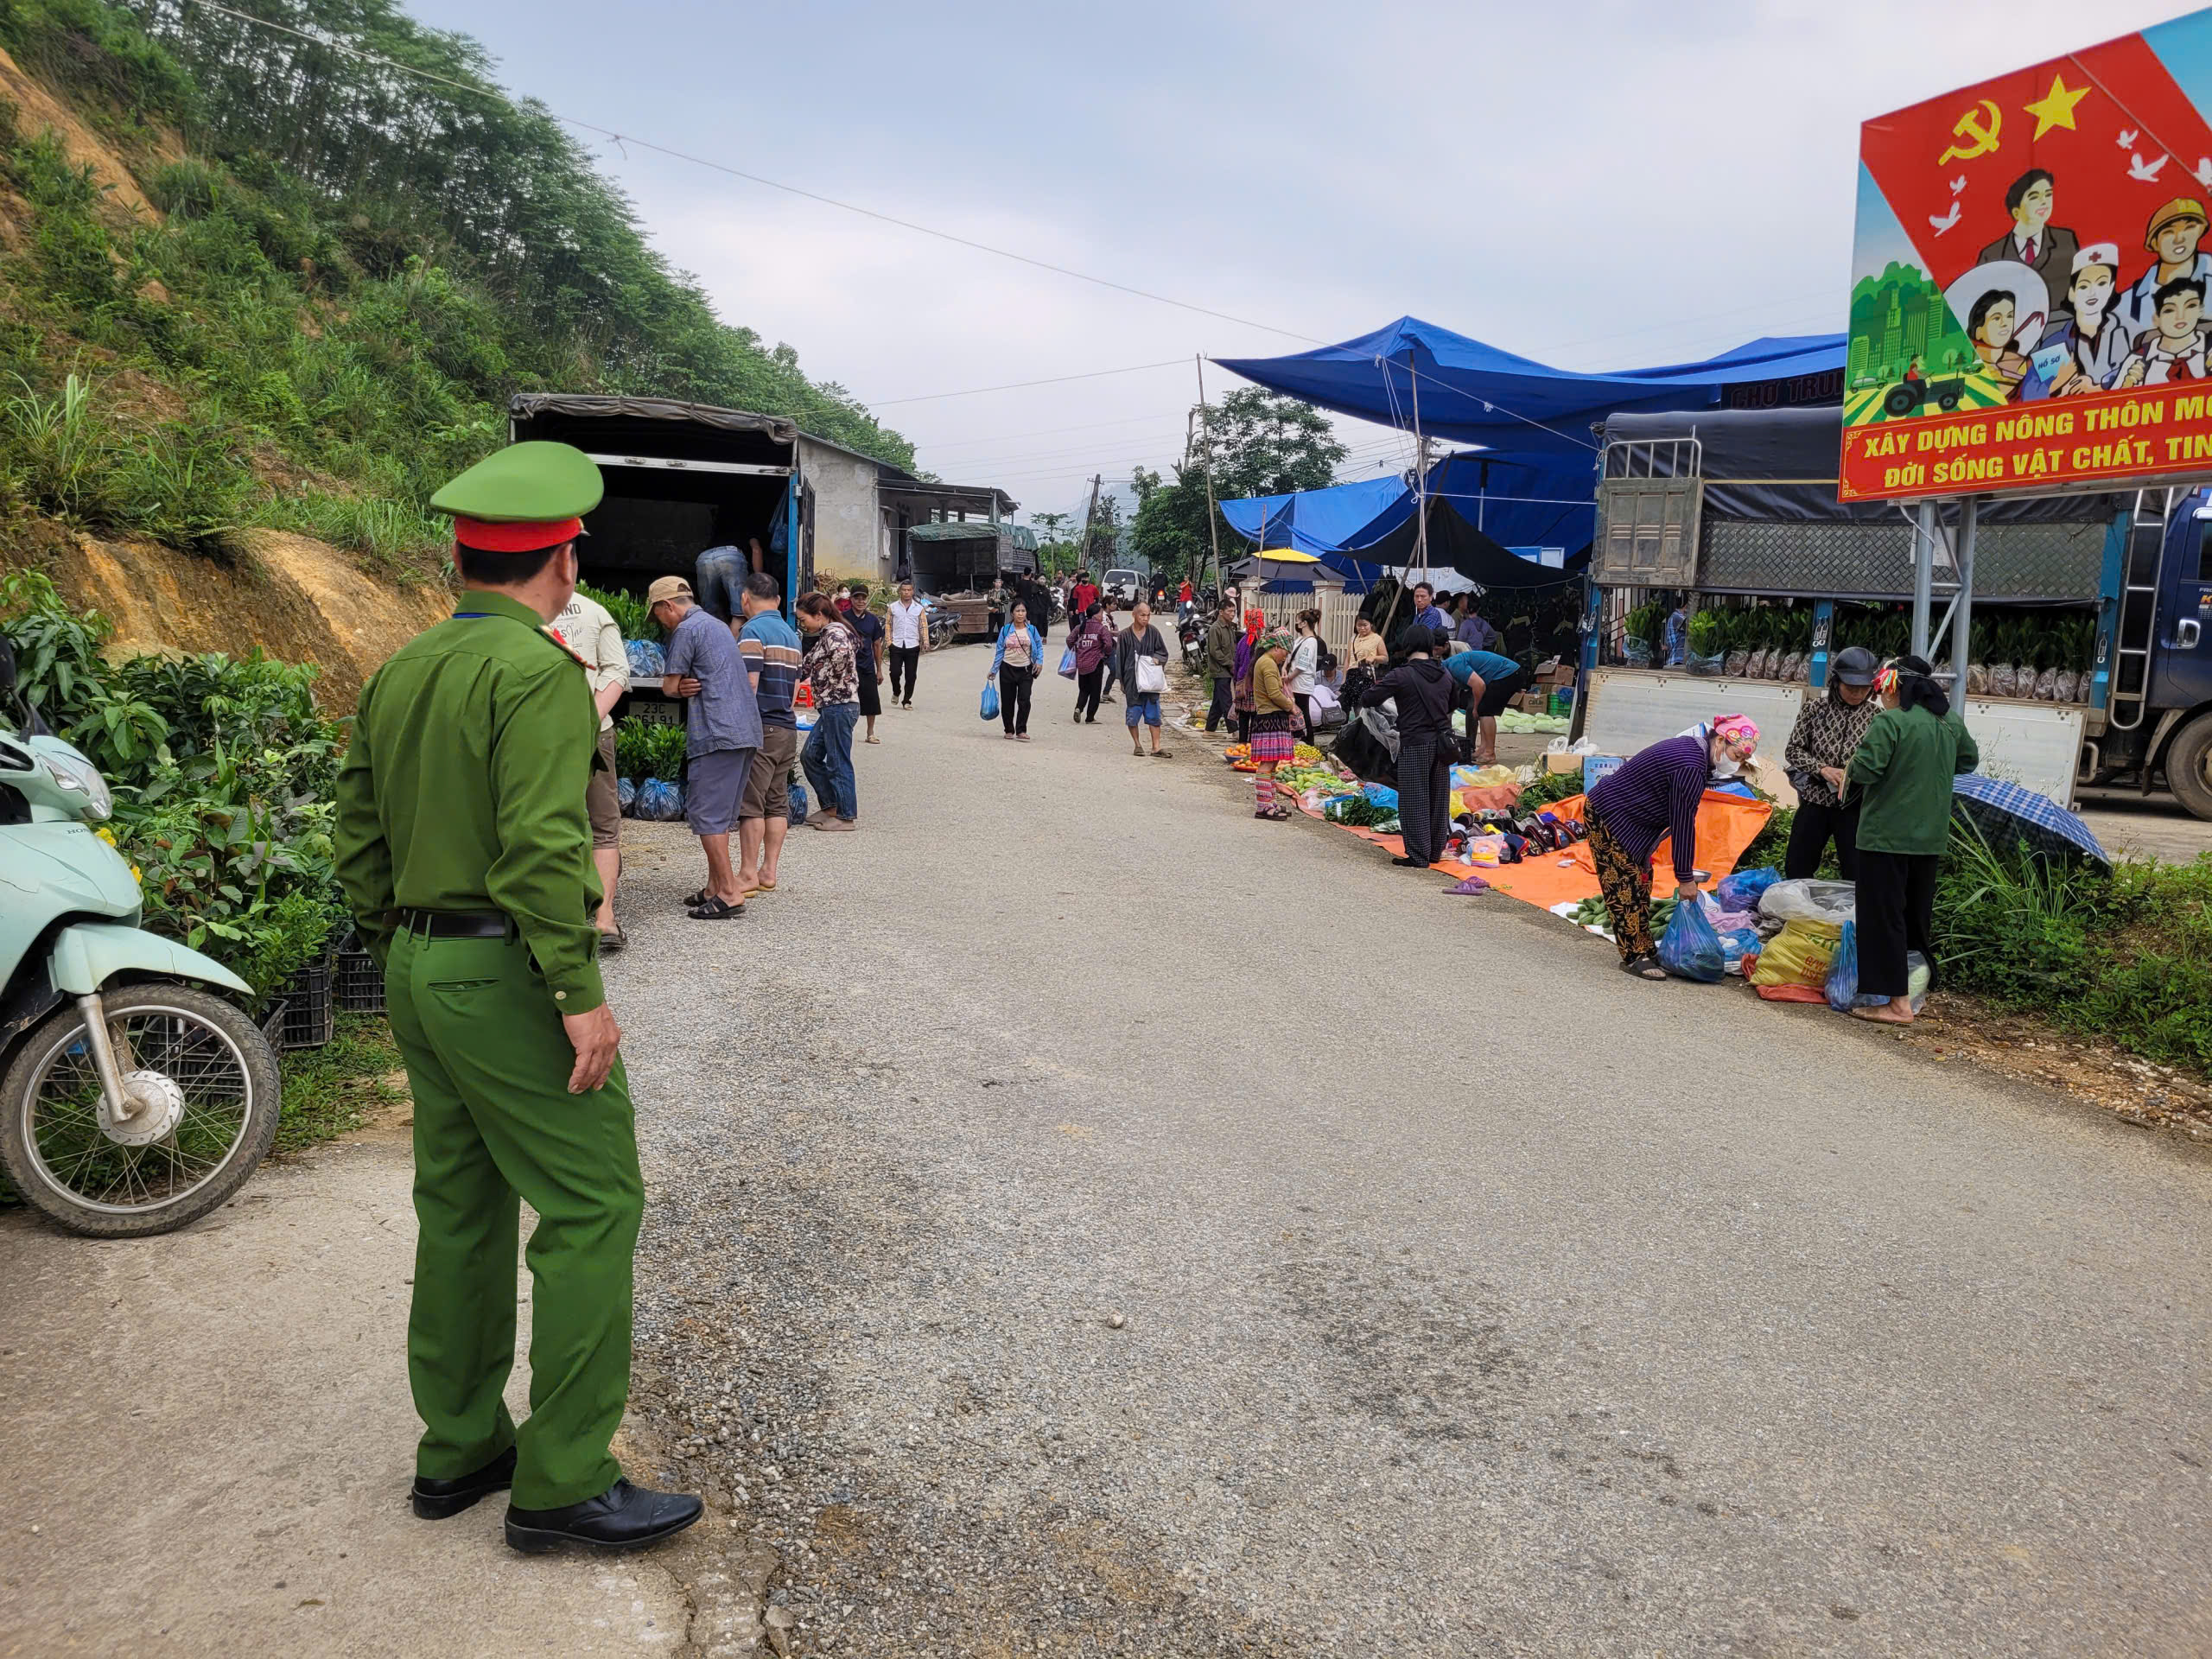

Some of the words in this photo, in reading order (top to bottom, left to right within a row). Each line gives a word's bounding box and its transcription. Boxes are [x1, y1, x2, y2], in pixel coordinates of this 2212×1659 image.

[1864, 432, 1910, 458] XÂY
[1917, 424, 1986, 454] DỰNG
[1995, 413, 2074, 442] NÔNG
[2084, 400, 2164, 432] THÔN
[1885, 461, 1925, 488] ĐỜI
[1933, 453, 2004, 483] SỐNG
[2012, 448, 2063, 478] VẬT
[2073, 435, 2154, 470] CHẤT,
[643, 703, 665, 714] 23C
